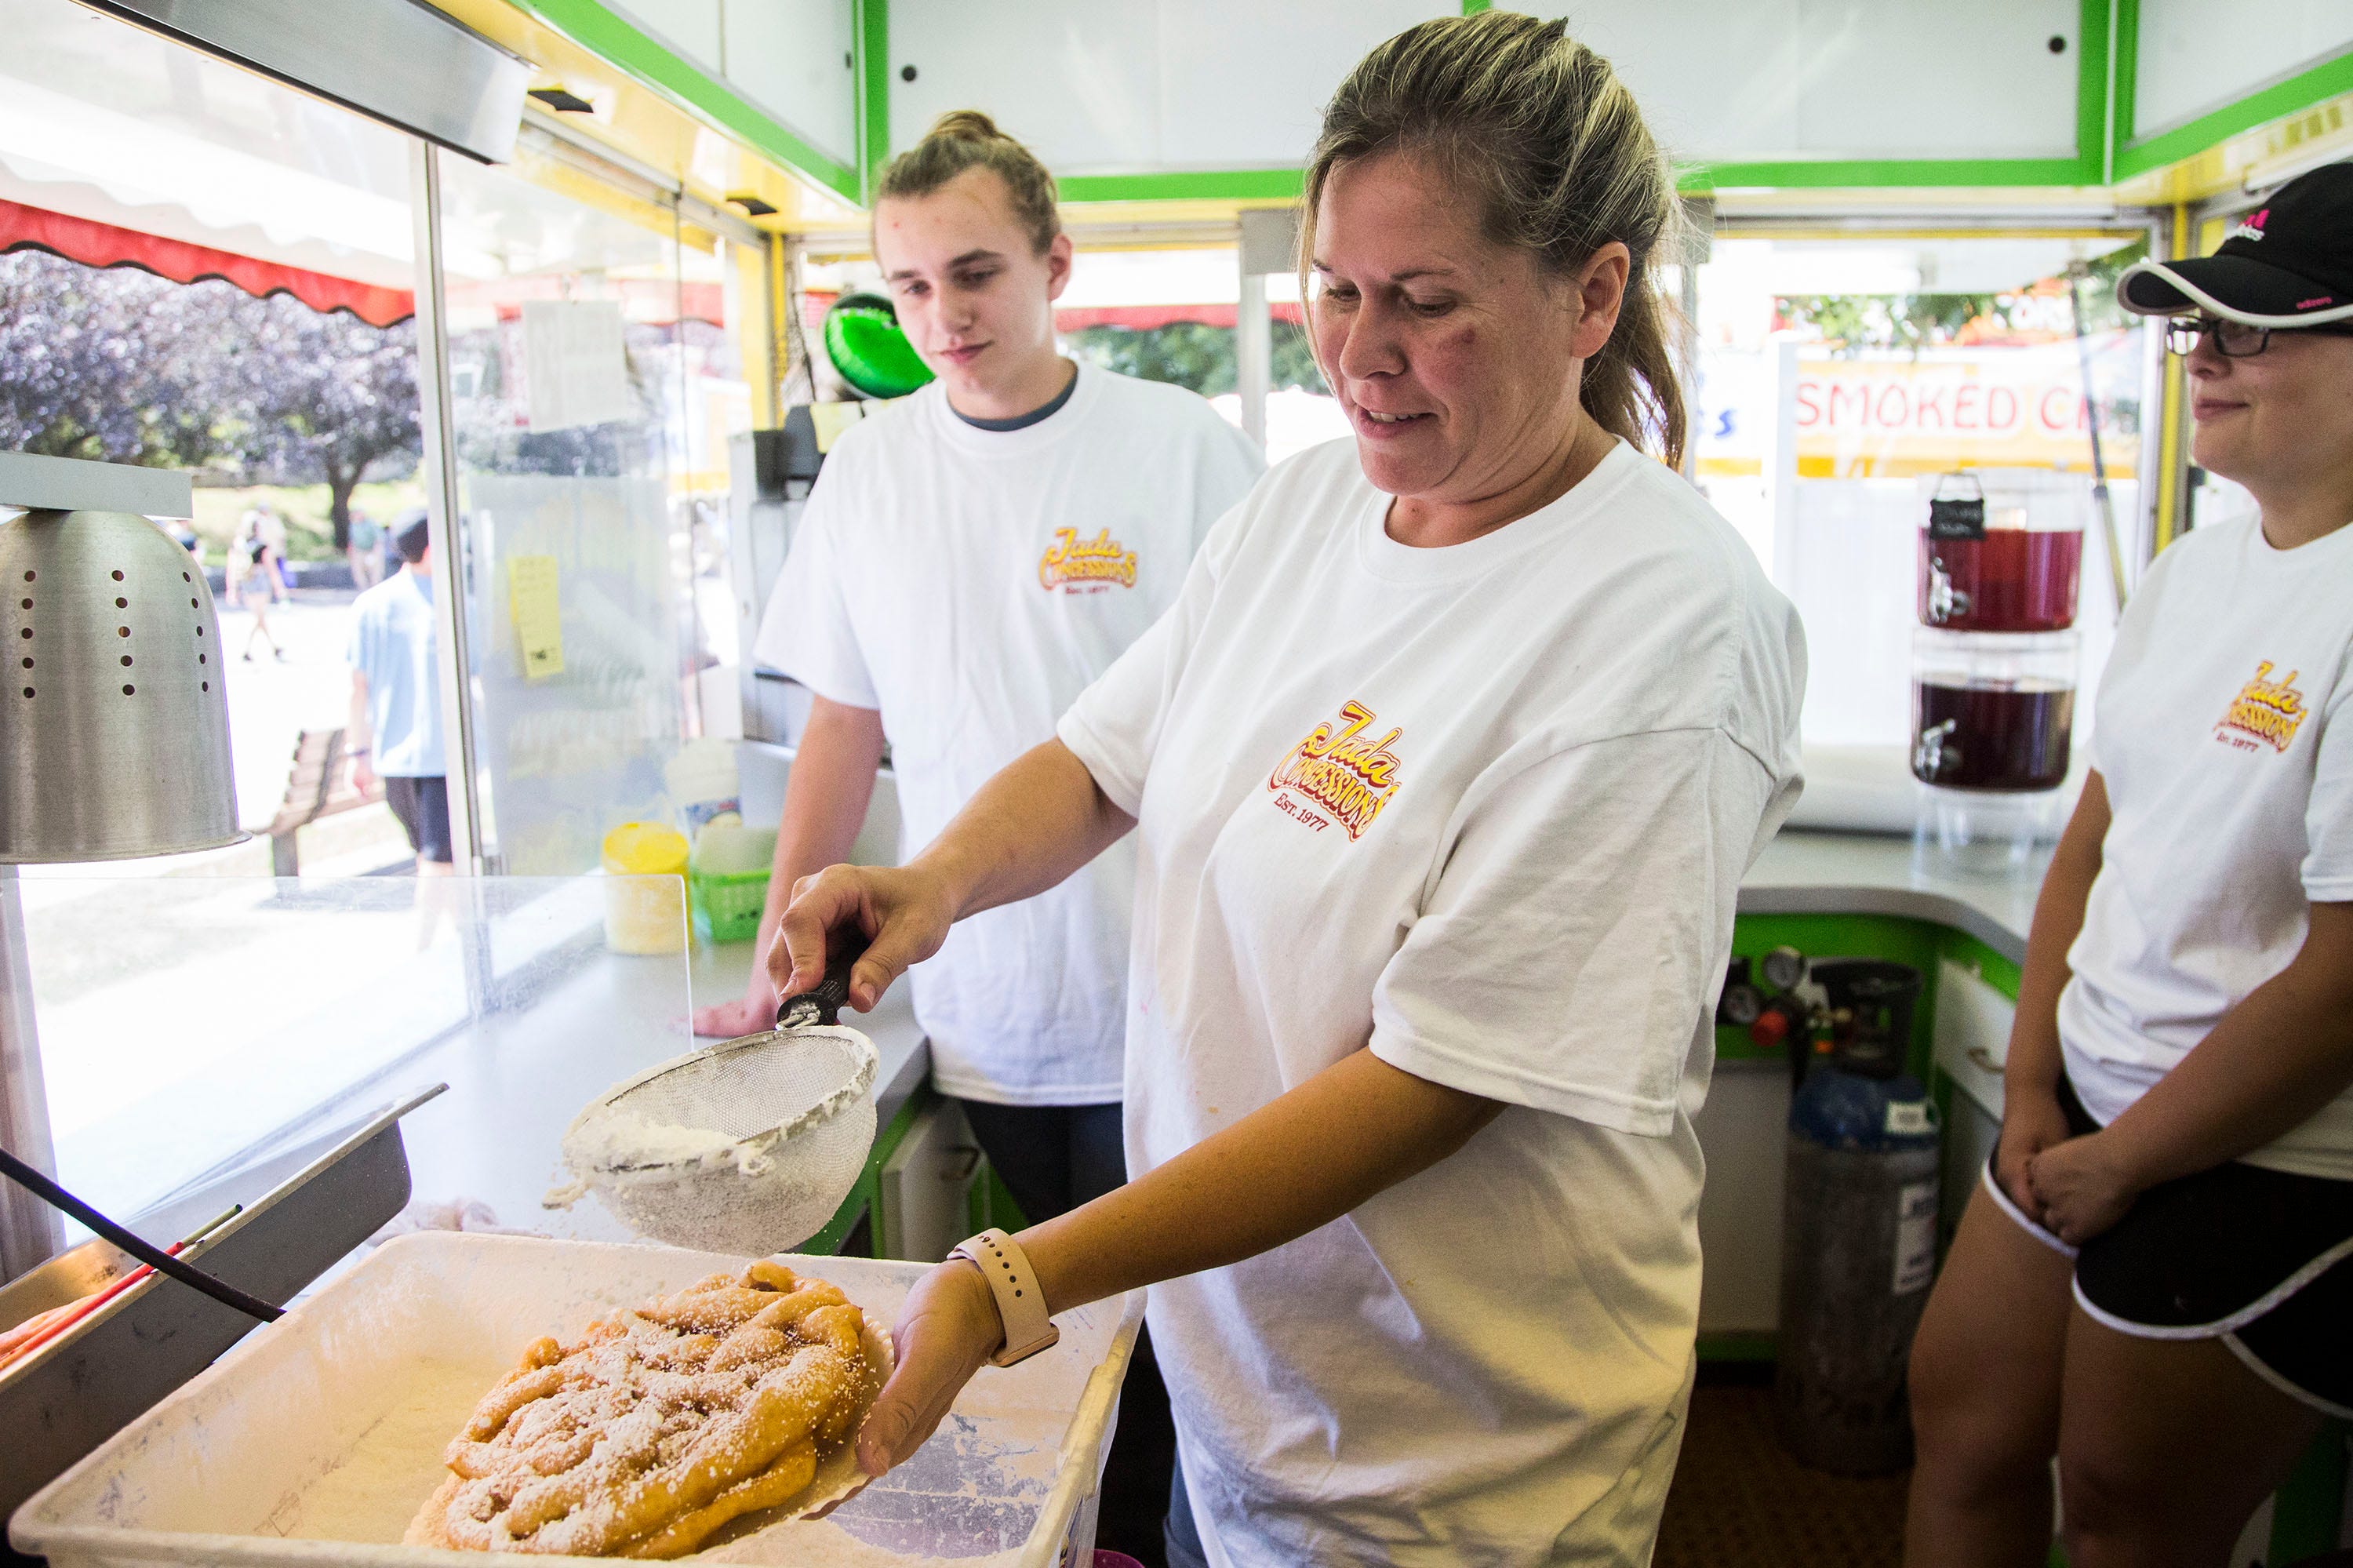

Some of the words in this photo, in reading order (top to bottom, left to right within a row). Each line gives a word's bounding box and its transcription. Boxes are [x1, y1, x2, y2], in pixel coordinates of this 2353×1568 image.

[1796, 382, 2017, 429] SMOKED
[1046, 528, 1122, 565] Jada
[1302, 700, 1402, 788] Jada
[1297, 808, 1329, 833] 1977
